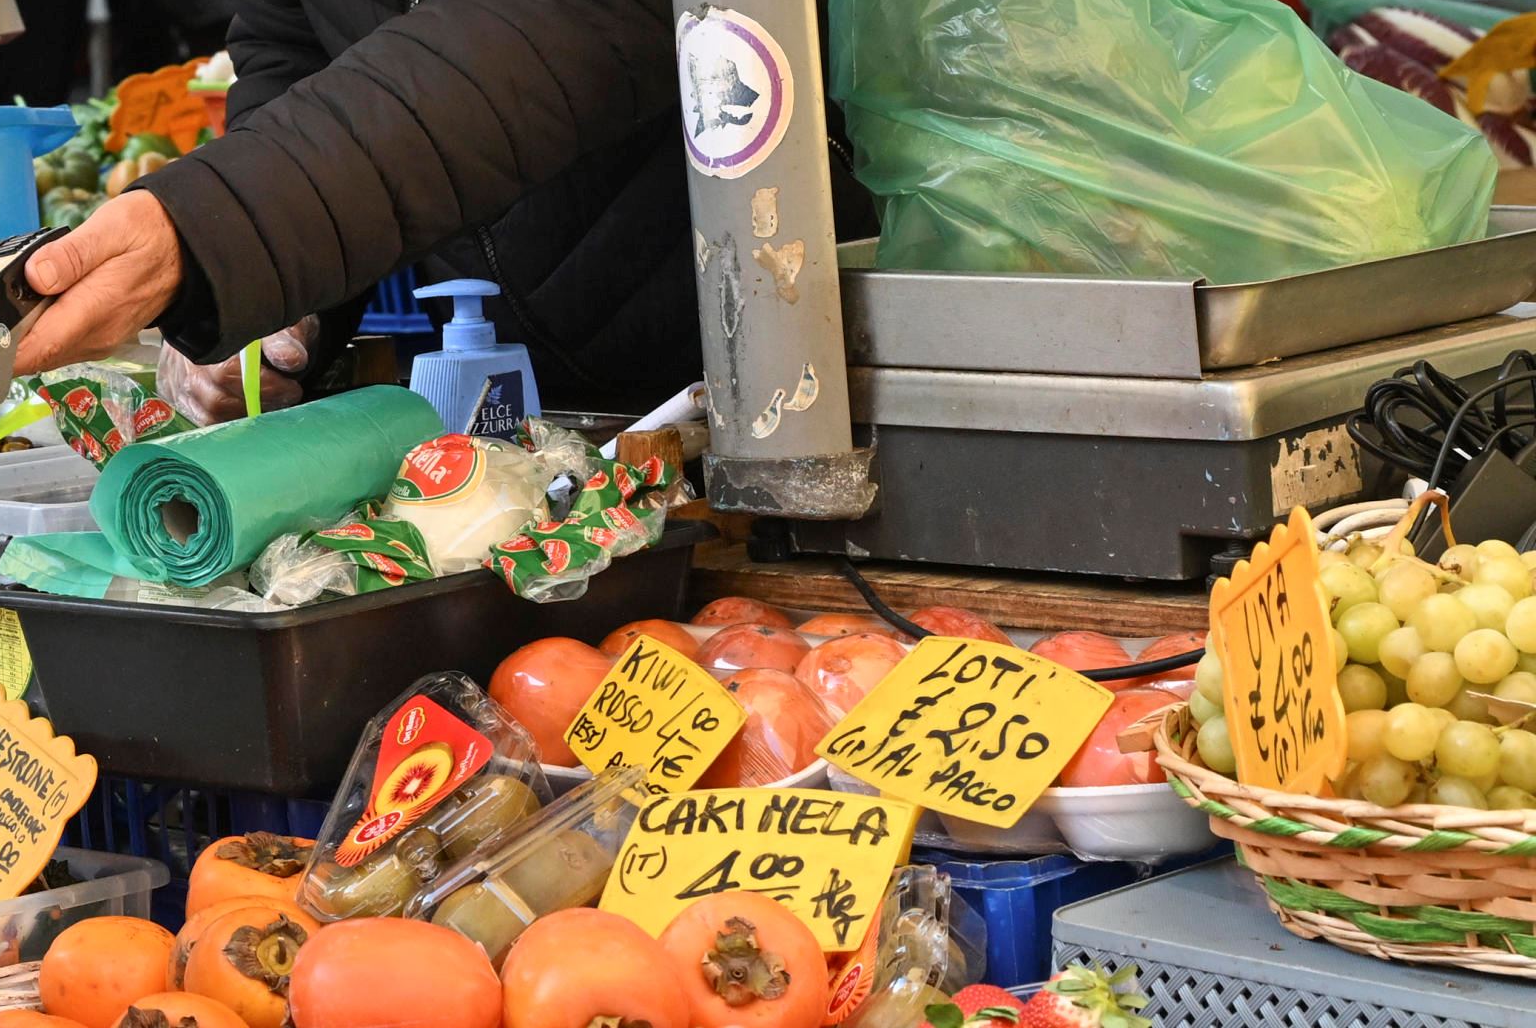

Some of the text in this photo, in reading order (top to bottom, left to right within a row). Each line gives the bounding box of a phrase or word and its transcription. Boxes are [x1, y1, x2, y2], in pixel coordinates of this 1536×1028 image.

[472, 418, 520, 436] ZZURRA
[481, 404, 512, 421] ELCE
[1243, 559, 1292, 671] UVA
[620, 640, 689, 701] KIWI
[593, 681, 654, 734] ROSSO
[871, 742, 922, 779] AL
[924, 760, 1017, 812] PACCO
[638, 794, 890, 846] CAKI MELA
[619, 843, 669, 895] (IT)
